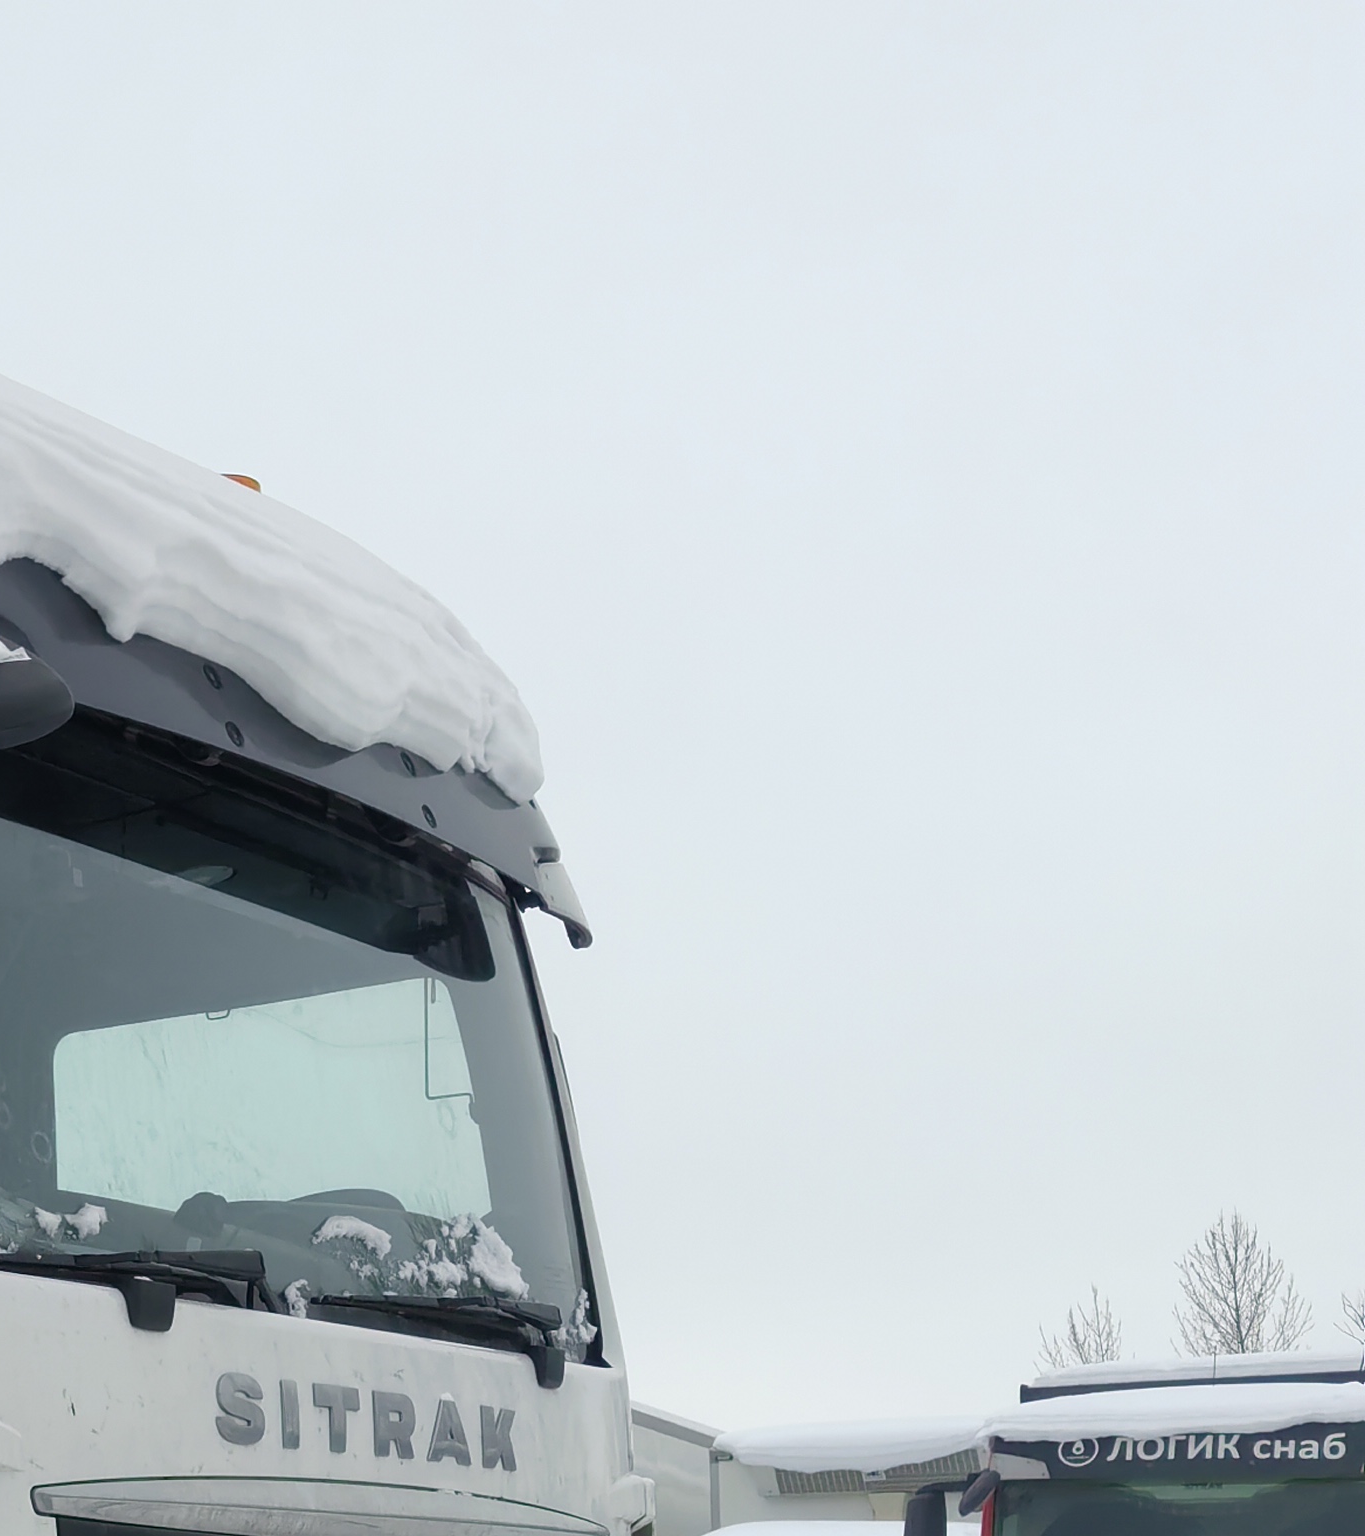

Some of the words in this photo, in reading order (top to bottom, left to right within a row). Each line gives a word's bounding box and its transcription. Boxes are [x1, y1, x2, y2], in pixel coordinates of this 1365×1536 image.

[215, 1371, 518, 1472] SITRAK
[1106, 1434, 1241, 1461] ЛОГИК
[1253, 1433, 1346, 1460] снаб
